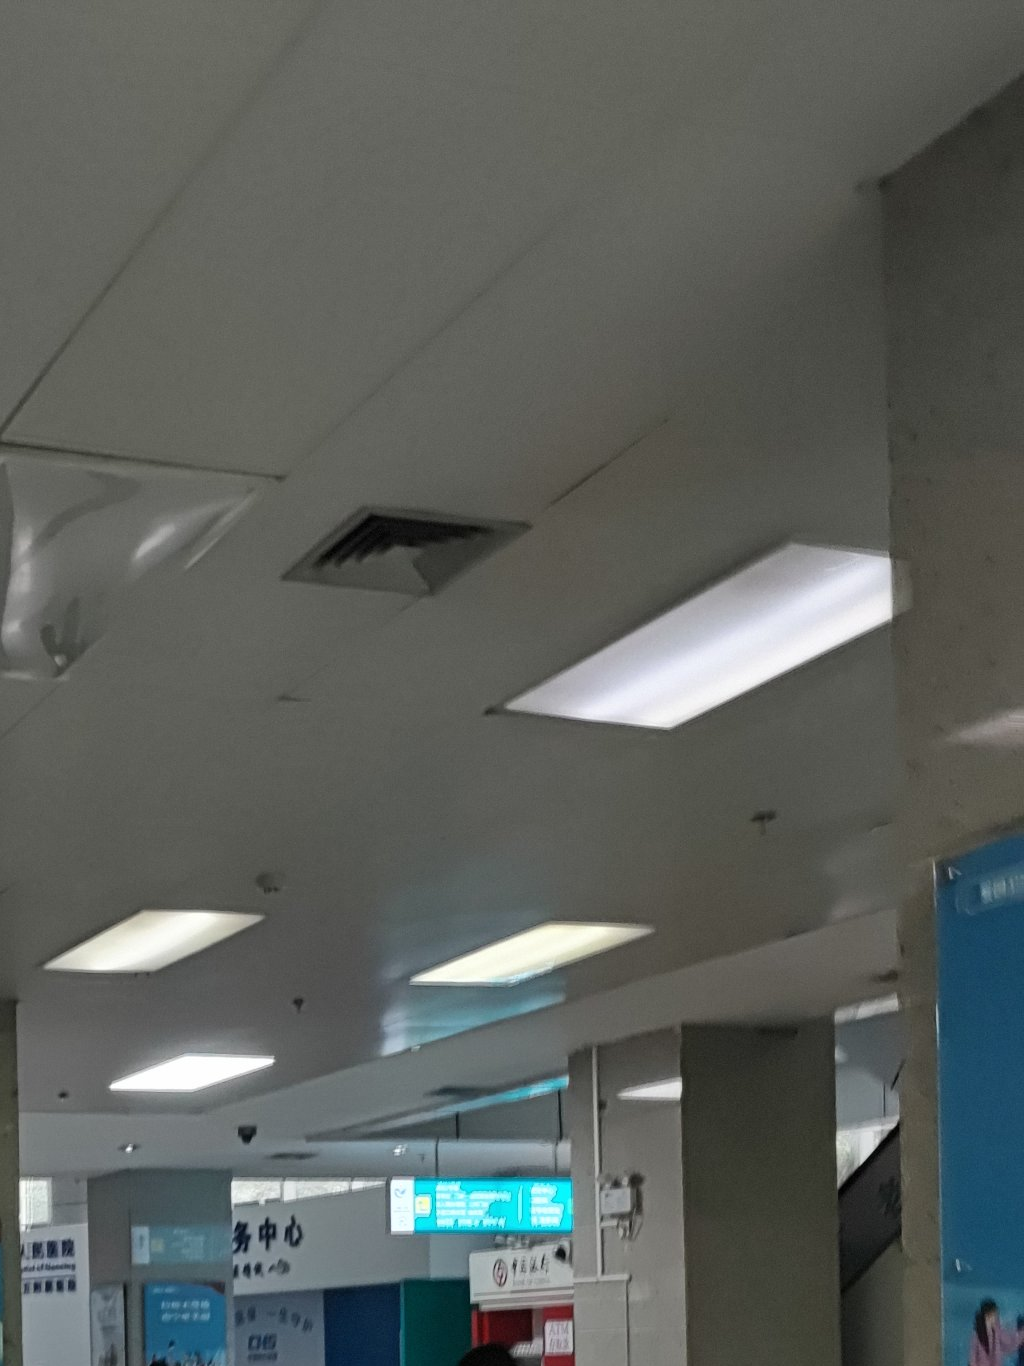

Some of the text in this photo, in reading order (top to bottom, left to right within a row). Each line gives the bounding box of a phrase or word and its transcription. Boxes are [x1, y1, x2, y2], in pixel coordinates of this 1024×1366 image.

[233, 1214, 303, 1254] 务中心
[512, 1253, 550, 1275] 中国银行
[549, 1323, 569, 1336] ATM
